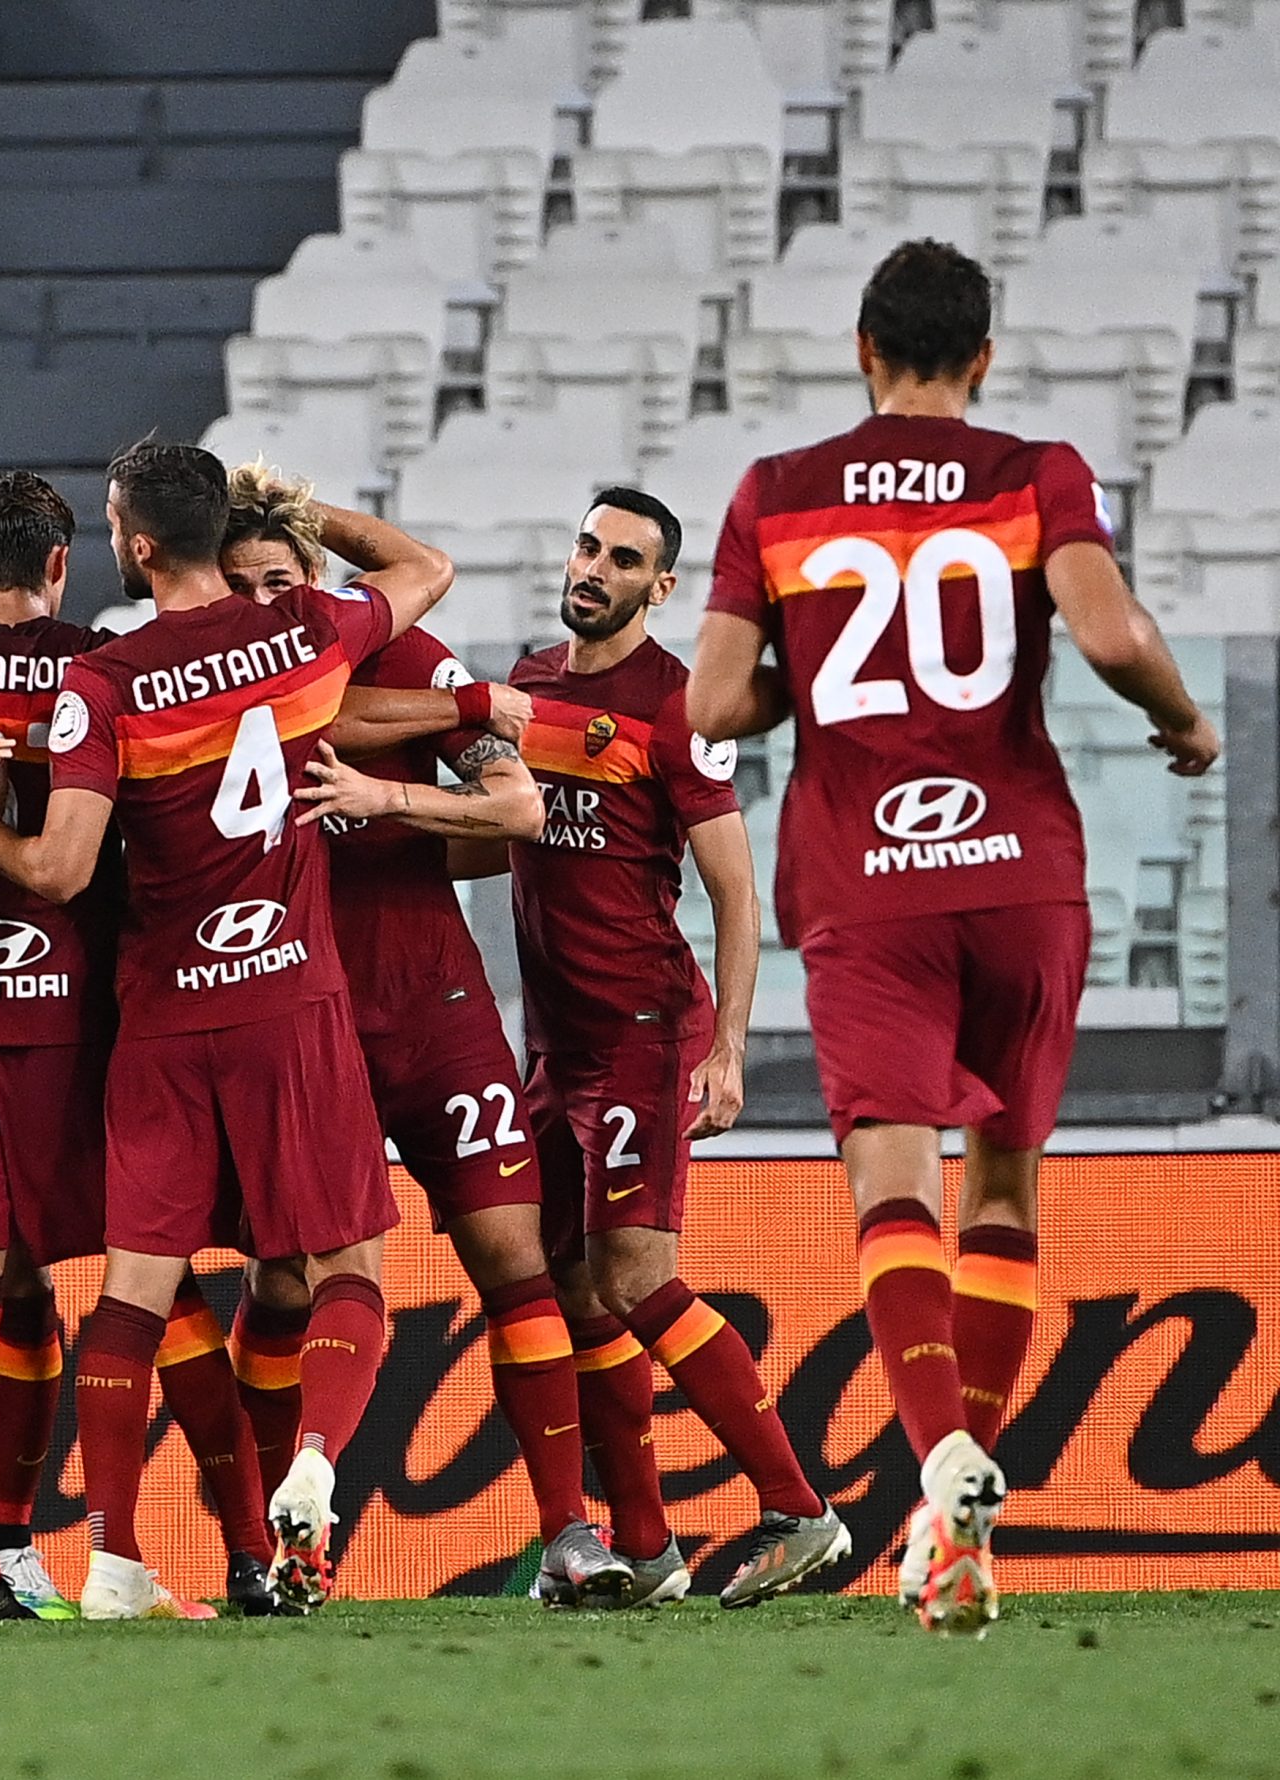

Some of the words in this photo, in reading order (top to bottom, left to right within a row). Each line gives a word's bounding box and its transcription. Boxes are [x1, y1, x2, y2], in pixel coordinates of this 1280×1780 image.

[843, 459, 965, 504] FAZIO
[800, 527, 1017, 727] 20
[131, 624, 318, 713] CRISTANTE
[210, 704, 293, 854] 4
[863, 833, 1023, 877] HYUNDAI
[176, 938, 309, 991] HYUNDAI
[445, 1082, 527, 1159] 22
[602, 1105, 641, 1169] 2
